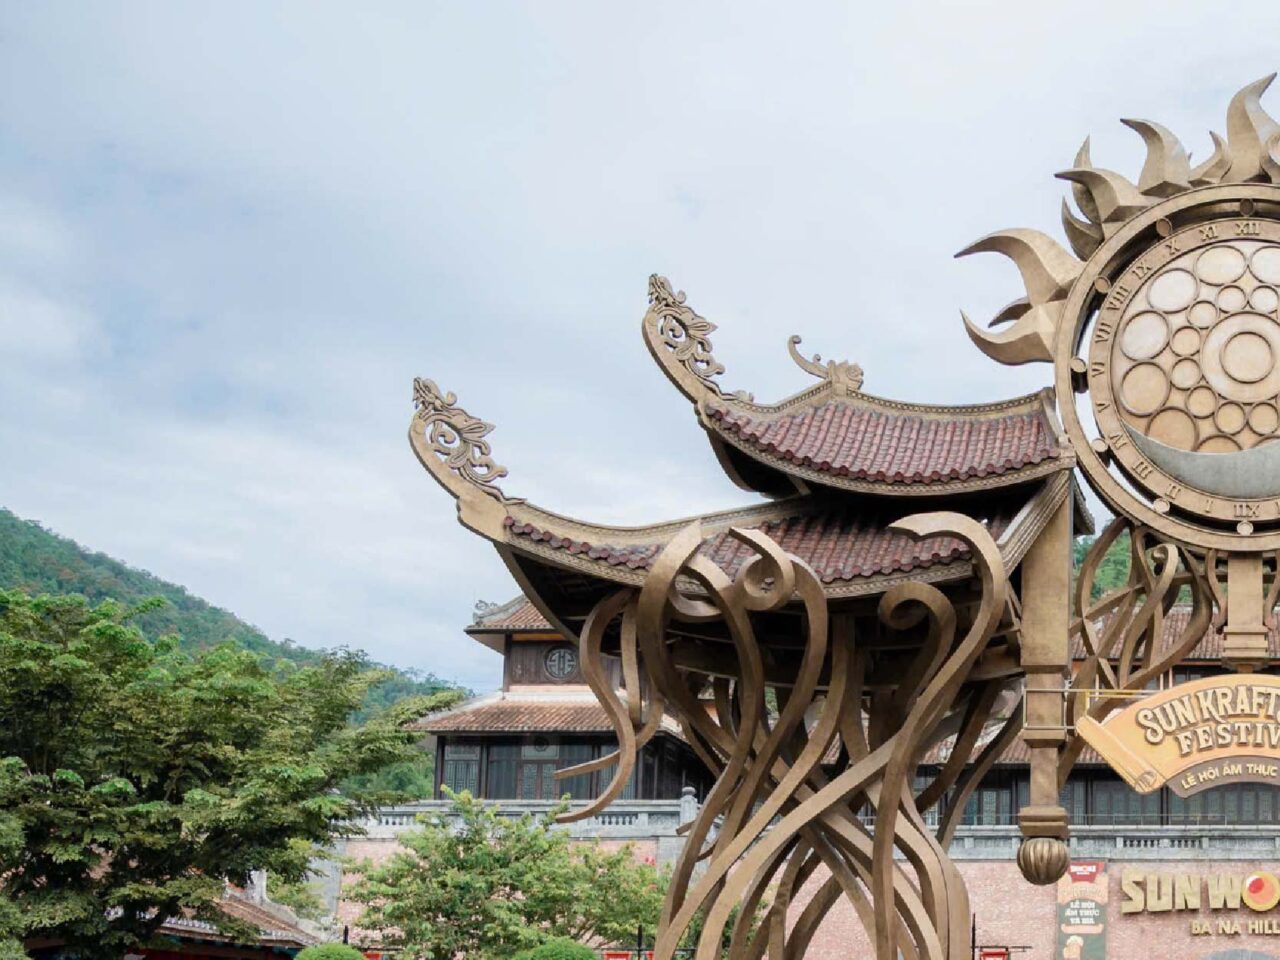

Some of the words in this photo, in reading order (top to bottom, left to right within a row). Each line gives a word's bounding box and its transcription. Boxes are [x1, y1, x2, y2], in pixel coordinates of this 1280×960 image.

[1199, 225, 1219, 242] XI
[1234, 221, 1261, 236] XII
[1137, 694, 1197, 745] SUN
[1181, 772, 1198, 789] LỄ
[1199, 766, 1219, 783] HỘI
[1246, 763, 1279, 777] THỰC
[1121, 869, 1200, 915] SUN
